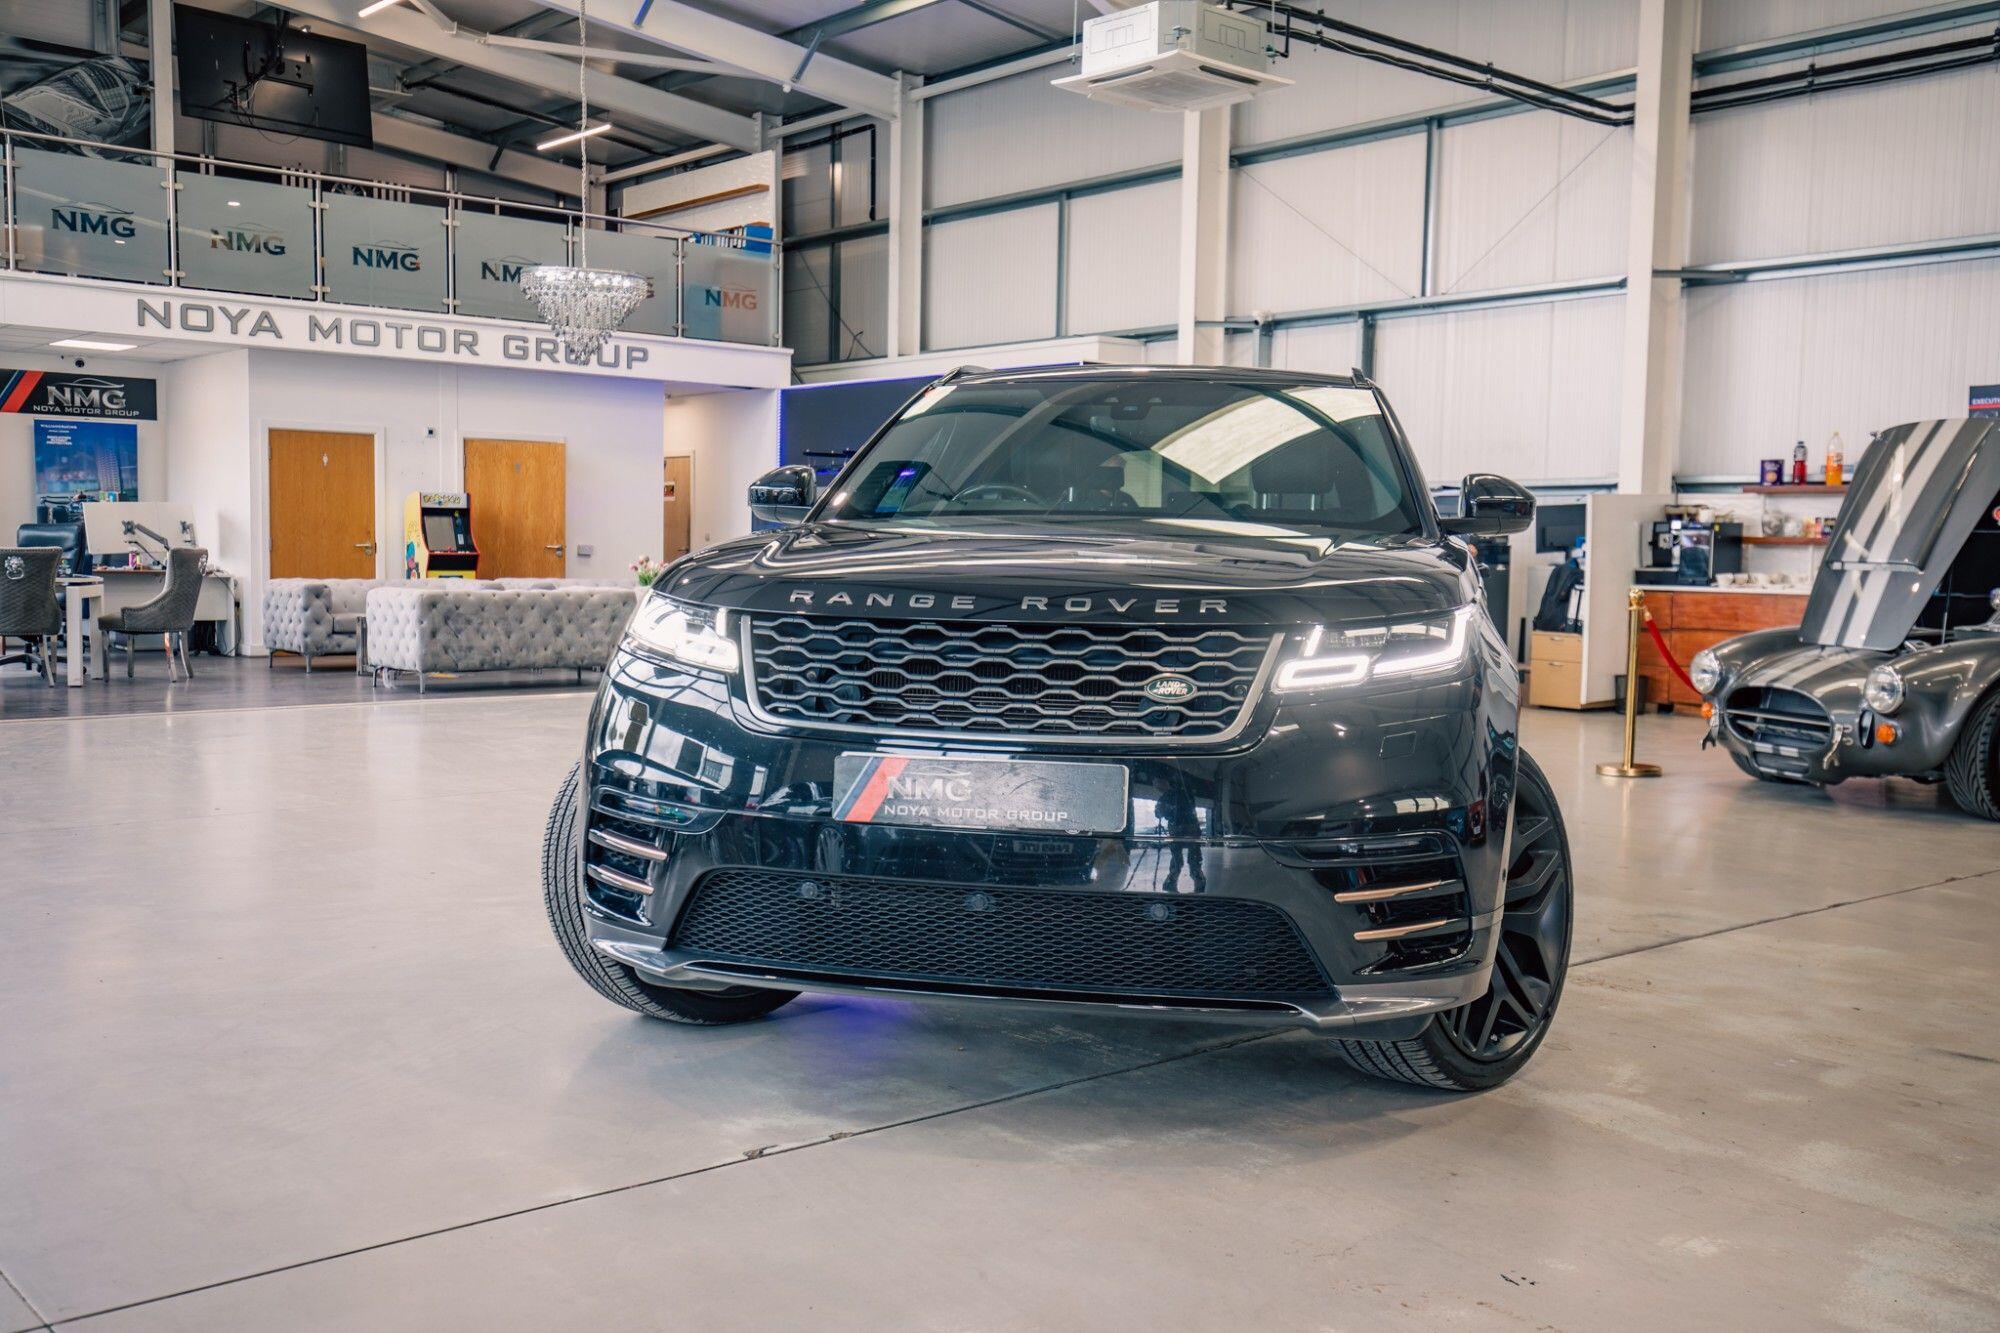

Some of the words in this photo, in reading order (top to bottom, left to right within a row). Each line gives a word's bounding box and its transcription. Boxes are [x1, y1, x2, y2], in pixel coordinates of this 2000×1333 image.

[51, 209, 136, 238] NMG
[210, 229, 286, 256] NMG
[352, 246, 421, 272] NMG
[481, 261, 523, 283] NM
[705, 289, 757, 310] NMG
[137, 298, 283, 340] NOYA
[308, 314, 480, 357] MOTOR
[47, 386, 126, 409] NMG
[33, 404, 61, 413] NOYA
[104, 409, 140, 417] GROUP
[789, 590, 976, 610] RANGE
[1020, 595, 1229, 614] ROVER
[1158, 687, 1188, 695] ROVER
[886, 776, 972, 802] NMG
[884, 804, 930, 817] NOYA
[937, 807, 1000, 820] MOTOR
[1007, 810, 1068, 822] GROUP
